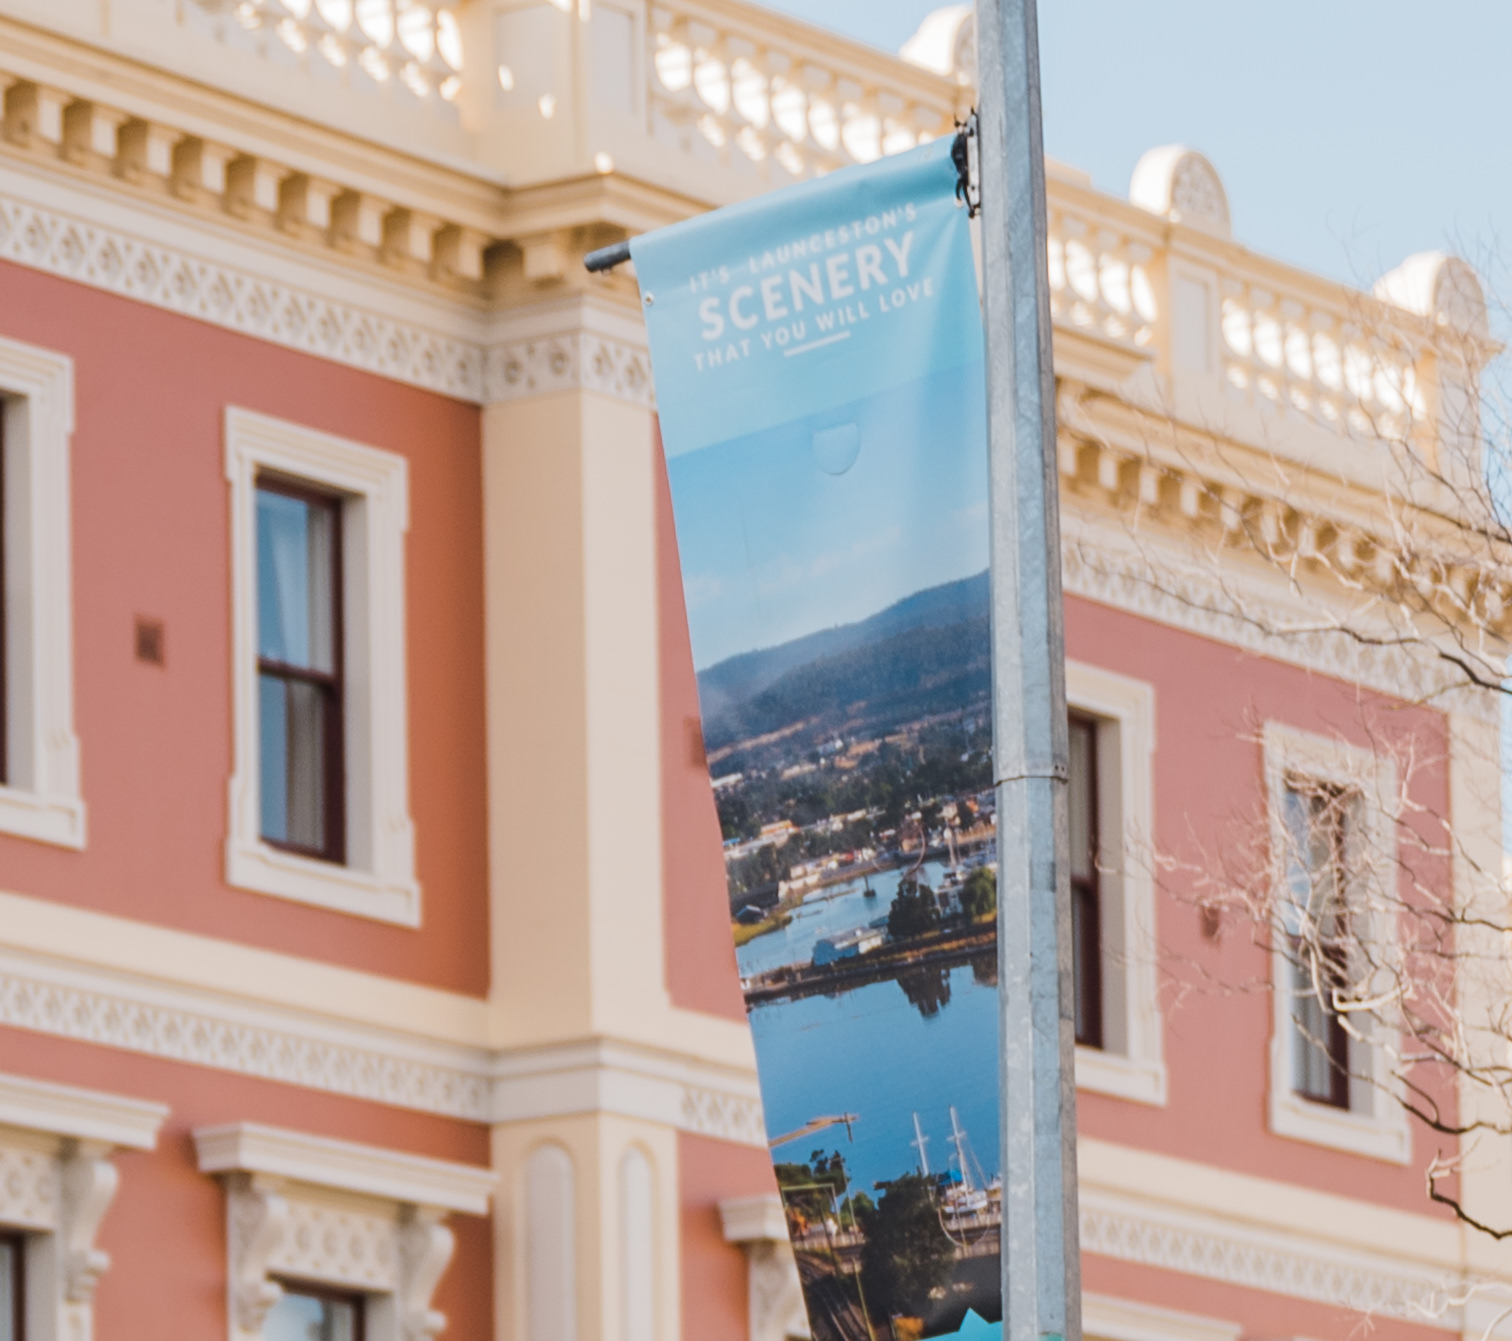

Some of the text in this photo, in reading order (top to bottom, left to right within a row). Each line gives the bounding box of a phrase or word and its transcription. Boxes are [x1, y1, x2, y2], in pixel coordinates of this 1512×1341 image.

[689, 202, 918, 294] IT'S LAUNCESTON'S
[698, 230, 915, 342] SCENERY
[693, 277, 935, 372] THAT YOU WILL LOVE
